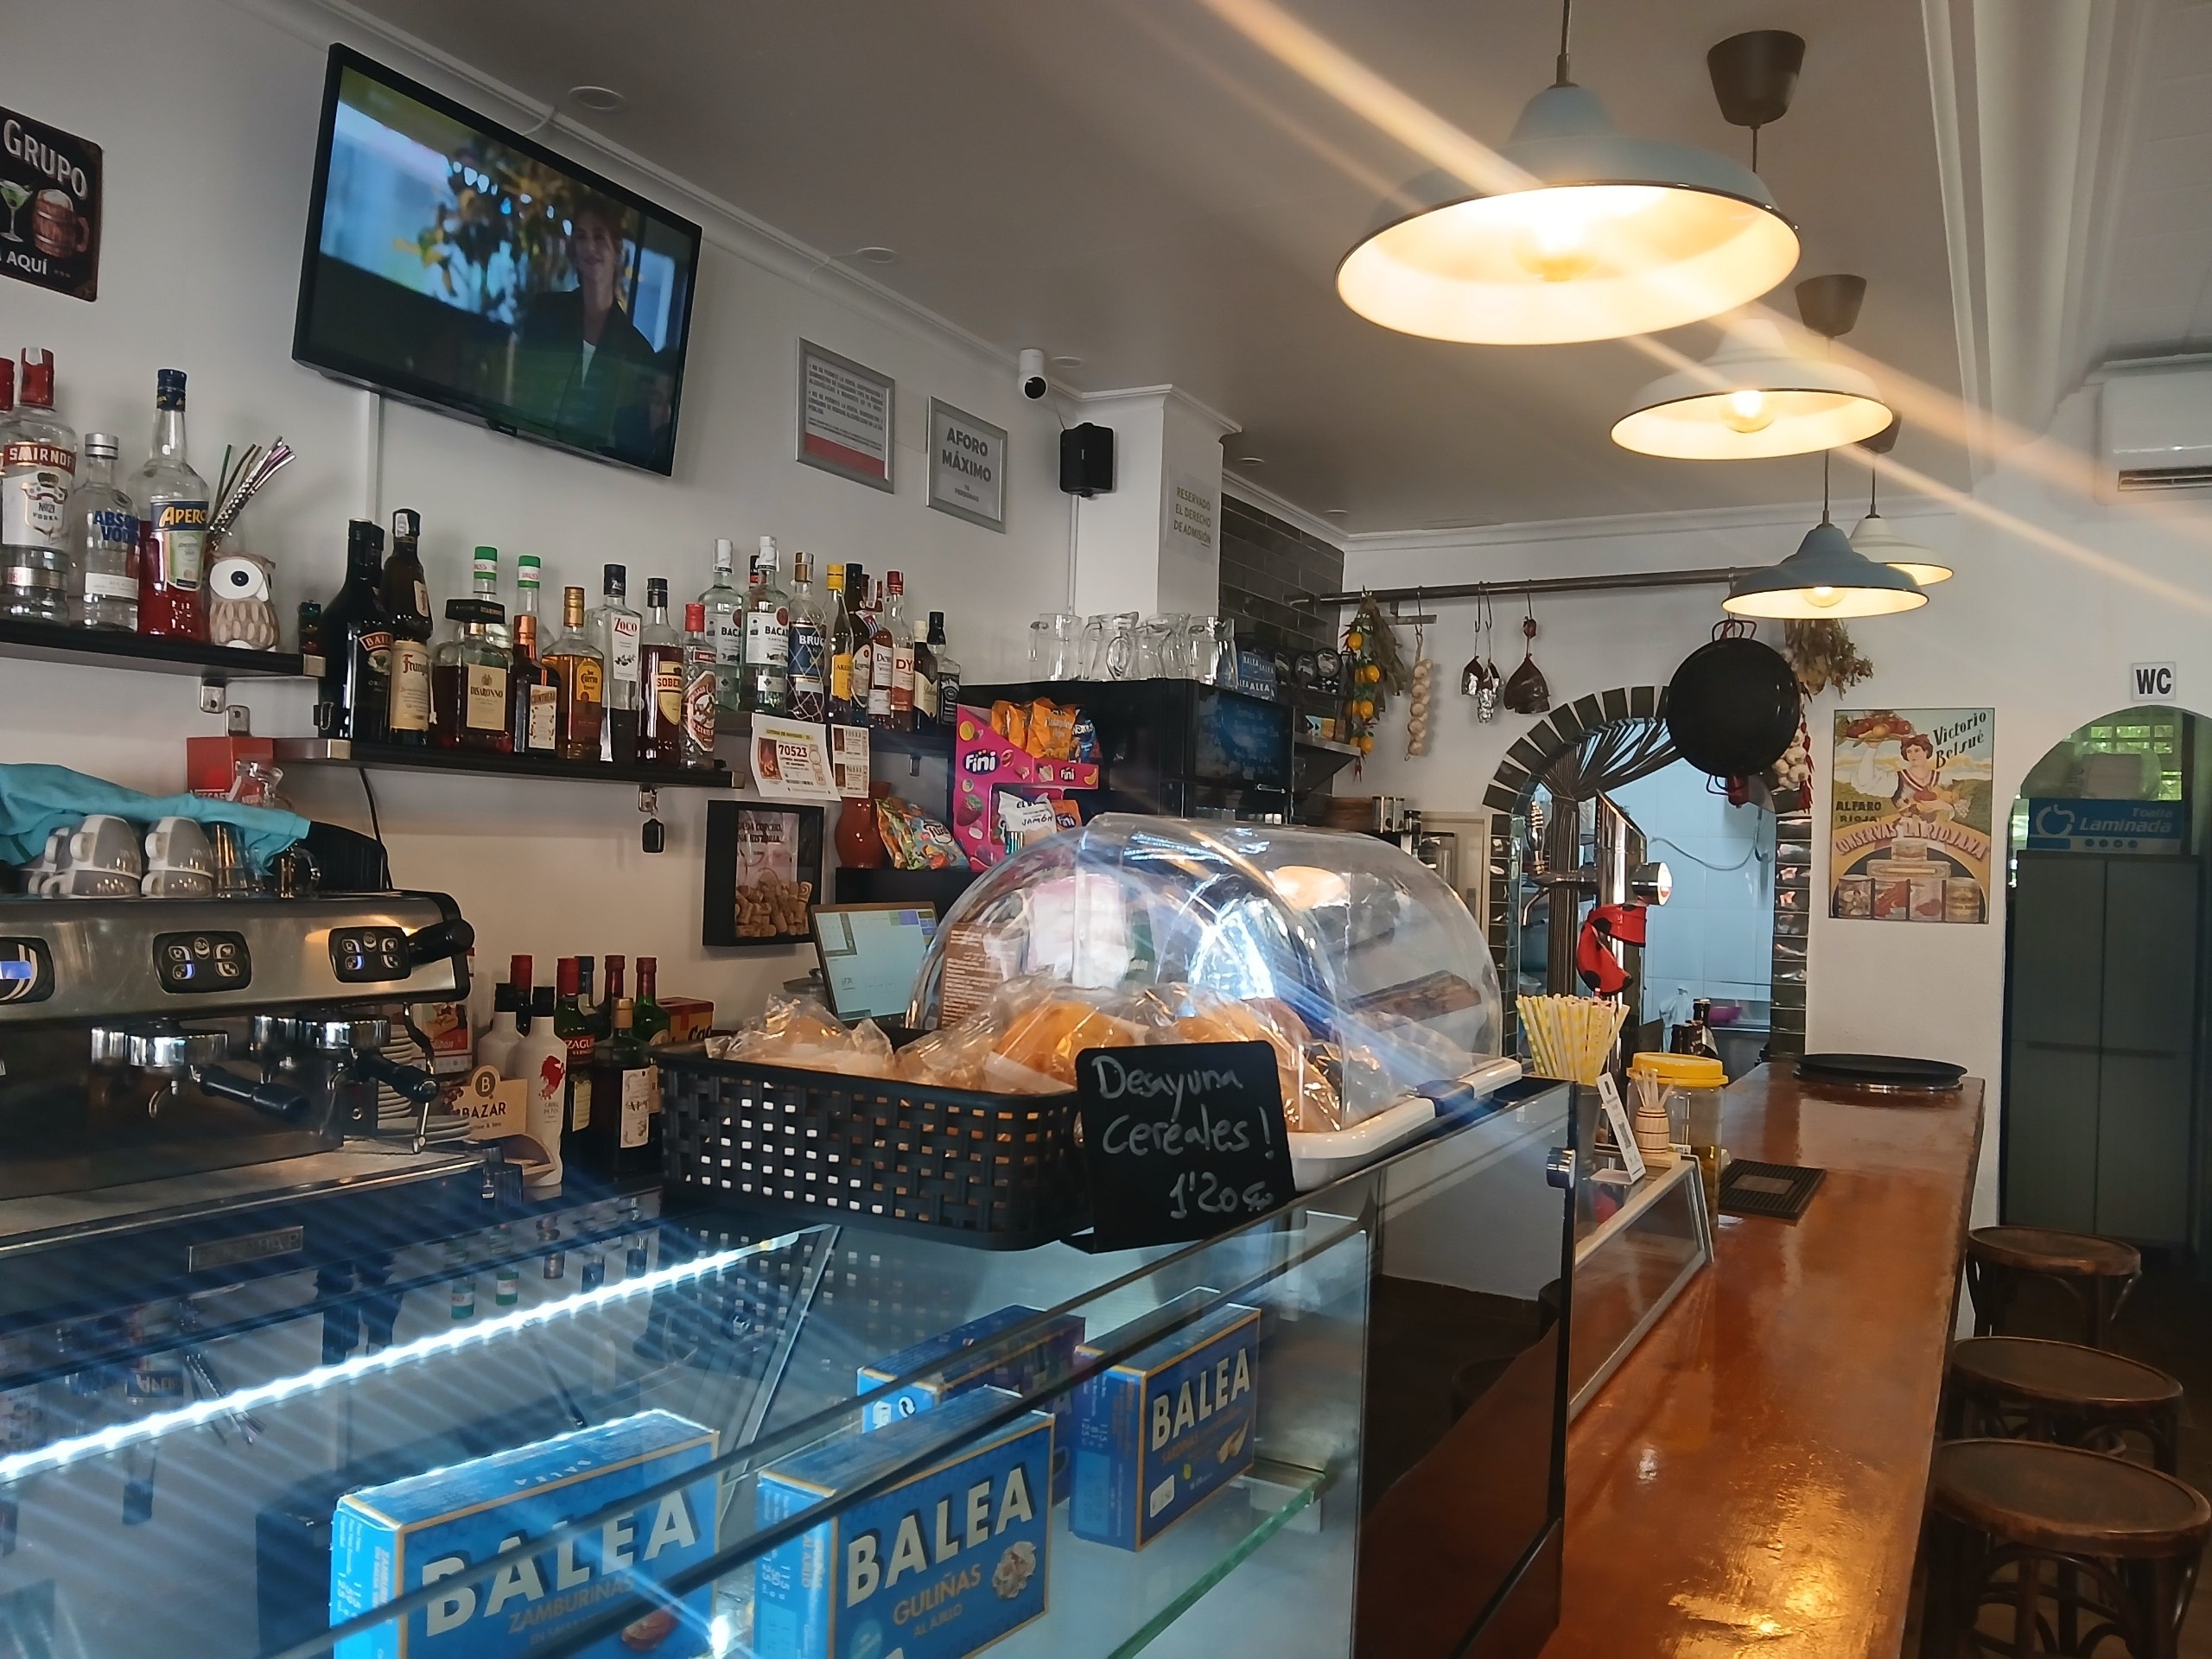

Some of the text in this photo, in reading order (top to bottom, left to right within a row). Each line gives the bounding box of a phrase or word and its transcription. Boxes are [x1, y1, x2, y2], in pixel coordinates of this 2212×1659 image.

[3, 119, 88, 200] GRUPO
[946, 427, 988, 457] AFORO
[10, 446, 74, 468] SMIRNOF
[942, 448, 992, 483] MÁXIMO
[1177, 486, 1211, 512] RESERVADO
[158, 506, 207, 528] APERO
[1173, 519, 1183, 532] DE
[1175, 503, 1211, 528] EL DERECHO
[896, 658, 913, 671] DY
[470, 686, 504, 698] DISARONNO
[2136, 668, 2172, 695] WC
[1933, 712, 1986, 746] Victorio
[779, 744, 807, 758] 70523
[965, 749, 996, 772] Fini
[1936, 729, 1985, 769] Belsué
[1060, 767, 1075, 780] Fini
[1836, 800, 1882, 811] ALFARO
[1021, 814, 1052, 826] JAMÓN
[2079, 817, 2172, 834] Laminada
[1836, 823, 1898, 855] CONSERVAS
[481, 1077, 490, 1092] B
[1152, 1347, 1251, 1452] BALEA
[846, 1466, 1034, 1609] BALEA
[422, 1490, 696, 1637] BALEA
[893, 1562, 982, 1626] GULIÑAS
